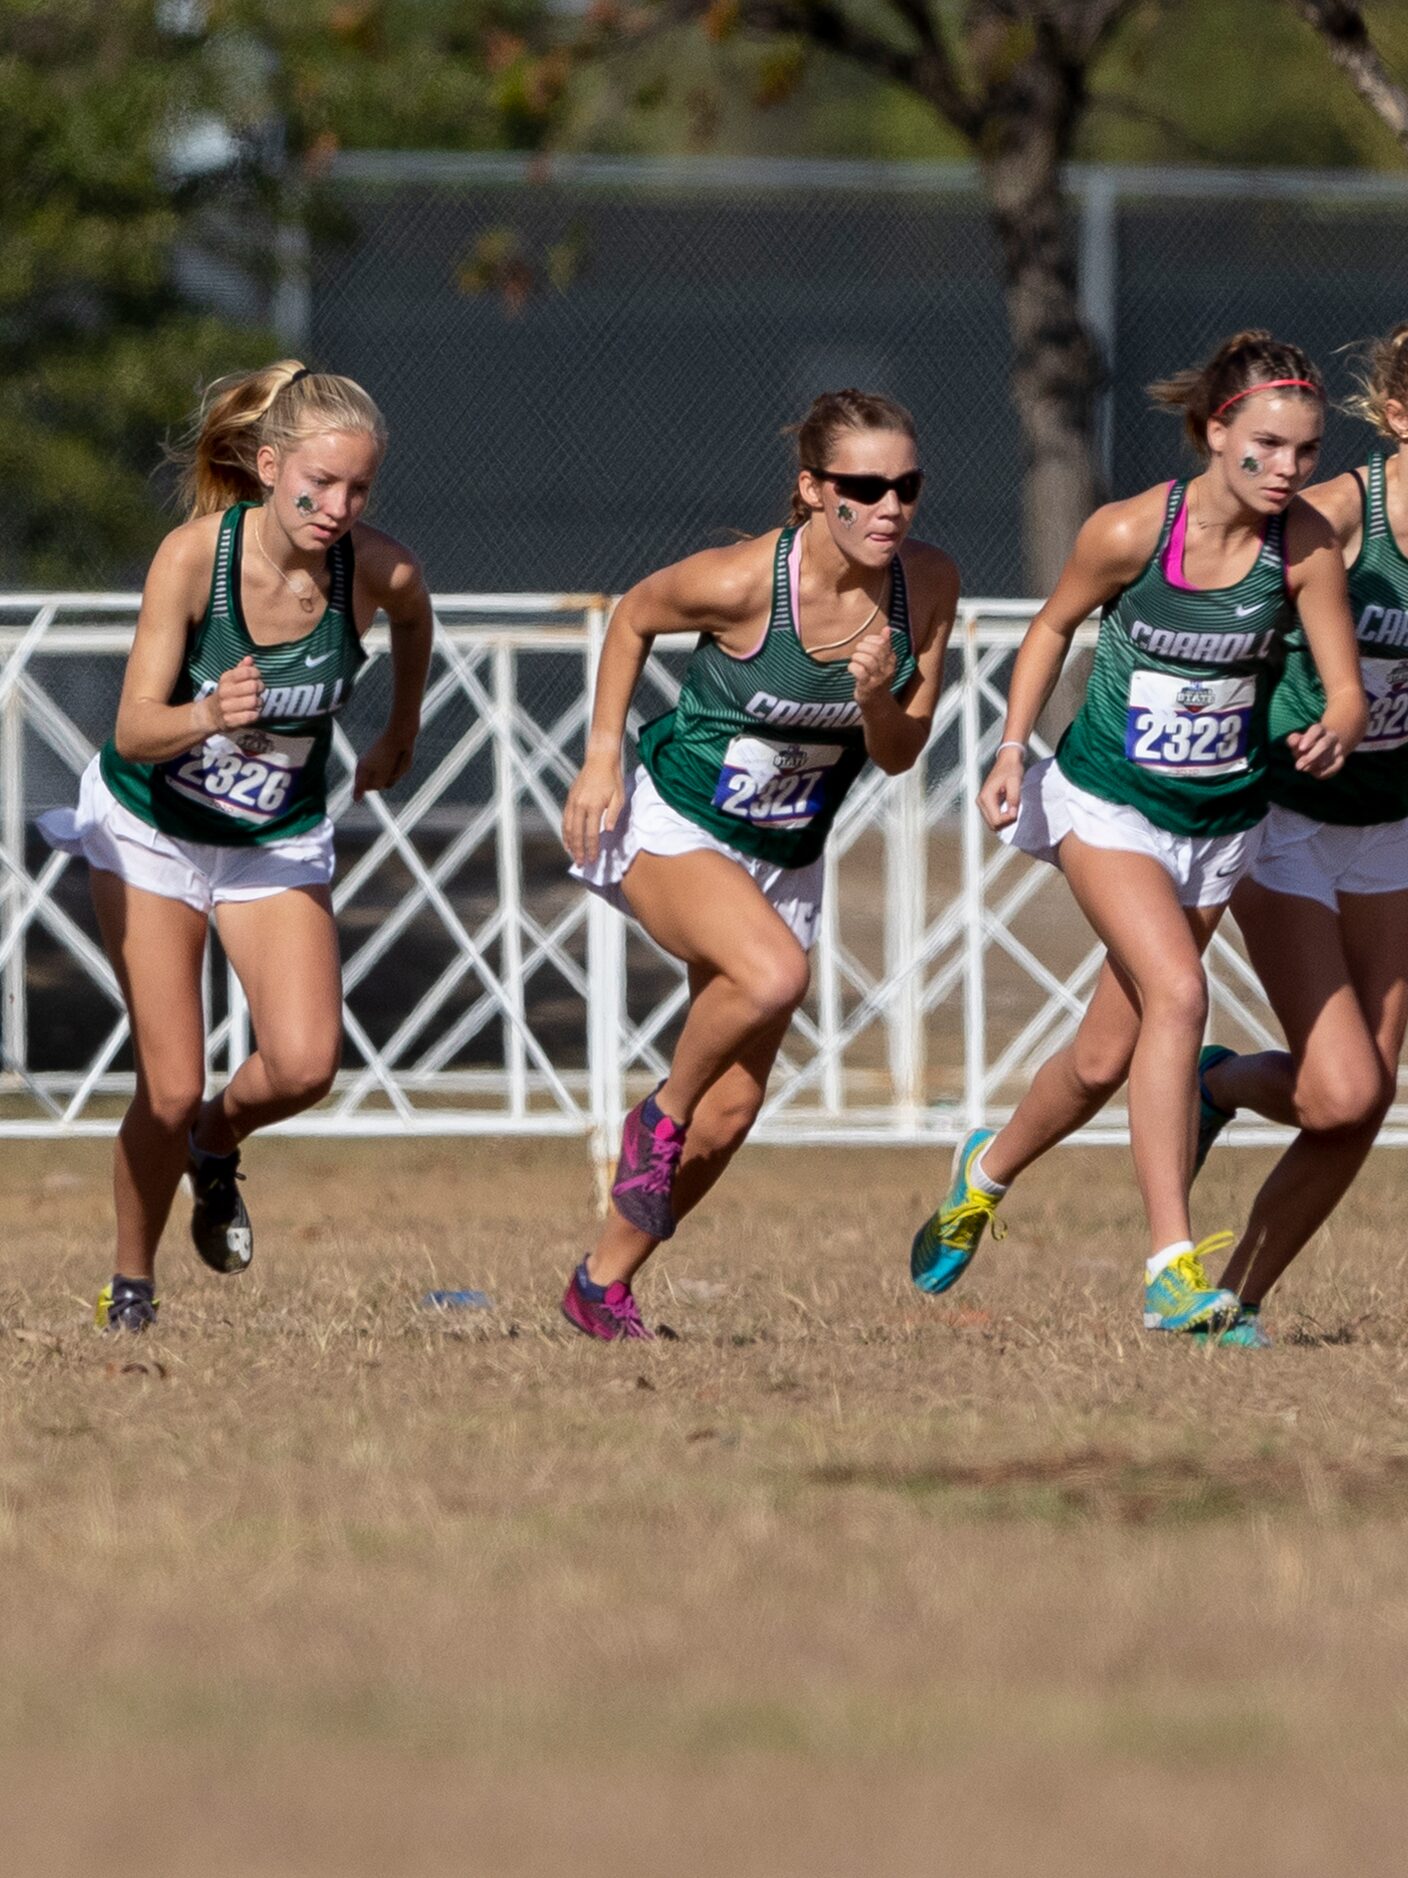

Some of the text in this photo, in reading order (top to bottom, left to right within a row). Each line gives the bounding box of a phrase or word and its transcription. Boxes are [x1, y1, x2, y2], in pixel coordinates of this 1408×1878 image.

[1131, 620, 1276, 663] CARROLL
[193, 679, 343, 718] CROLL
[1135, 713, 1242, 762] 2323
[178, 753, 292, 812] 2326
[722, 769, 824, 818] 2327
